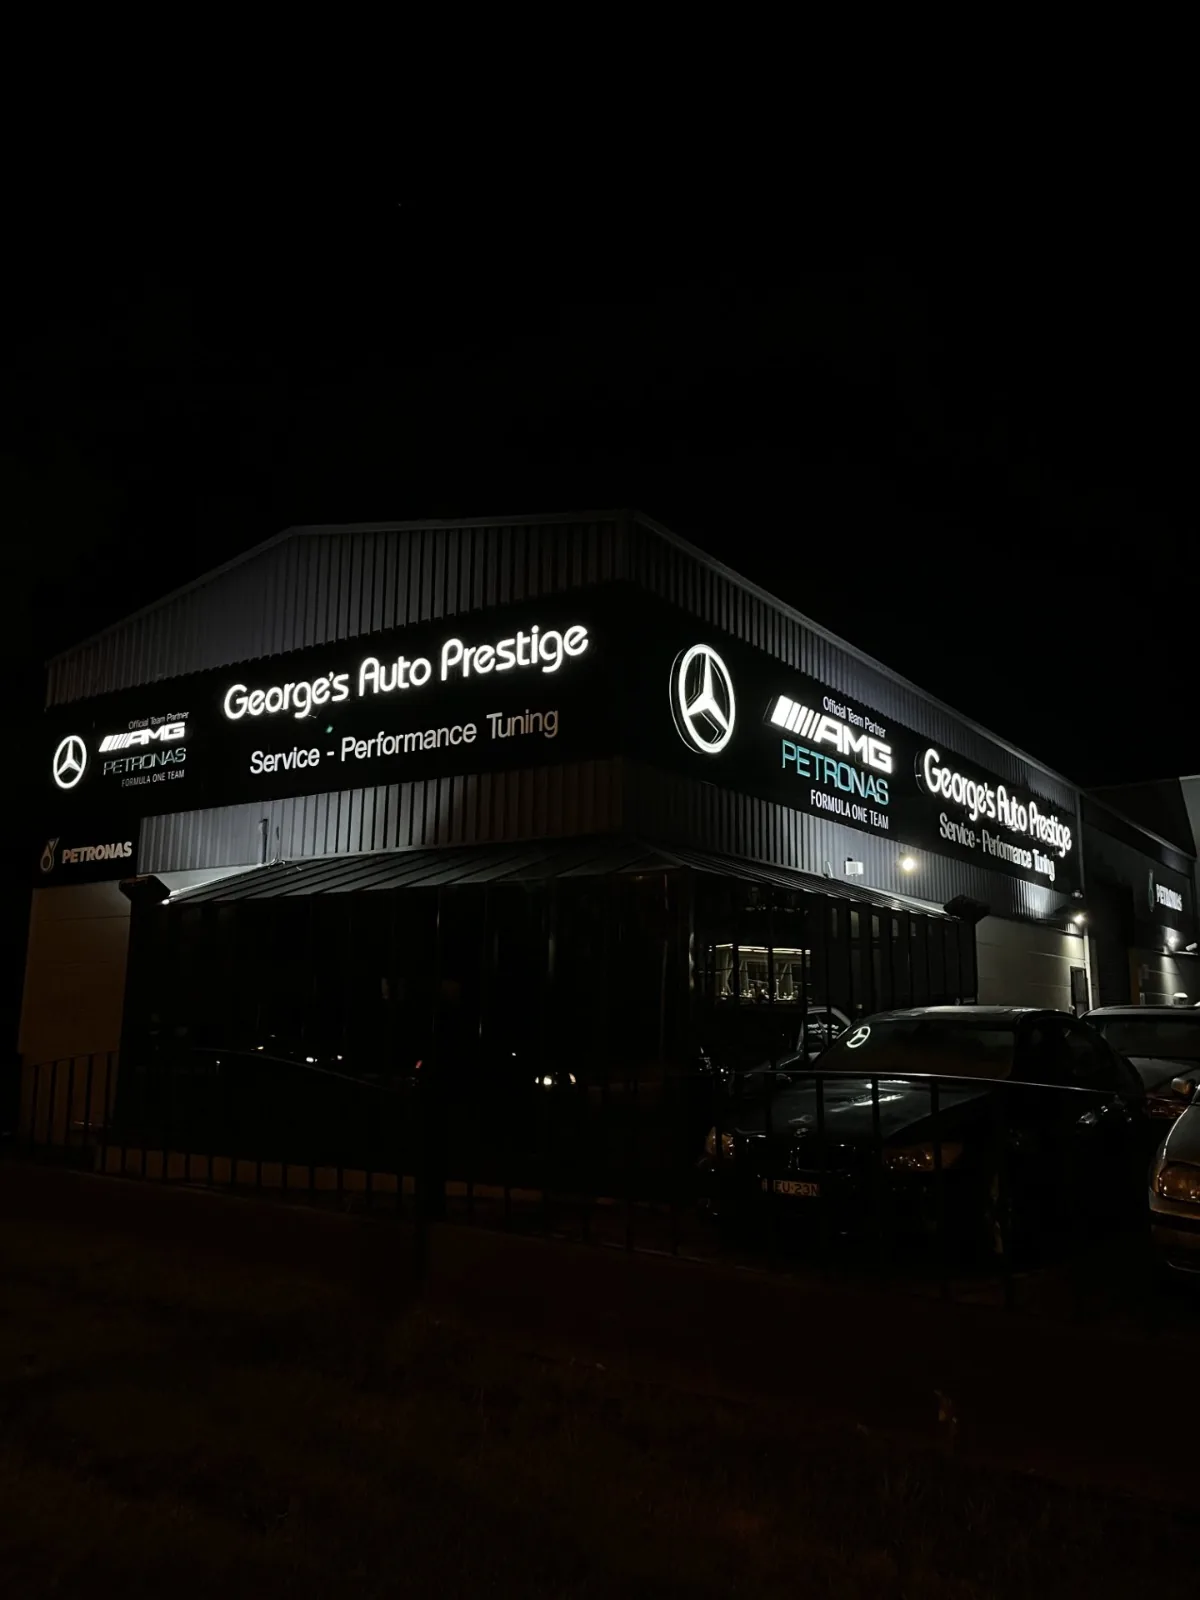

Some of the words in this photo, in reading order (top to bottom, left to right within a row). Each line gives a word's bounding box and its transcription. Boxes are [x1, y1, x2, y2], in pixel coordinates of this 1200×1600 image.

[223, 671, 349, 720] George's
[358, 655, 432, 697] Auto
[440, 624, 589, 681] Prestige
[128, 719, 149, 730] Official
[150, 715, 166, 725] Team
[166, 711, 189, 723] Partner
[822, 696, 847, 719] Official
[846, 707, 864, 728] Team
[864, 716, 887, 738] Partner
[103, 748, 187, 775] PETRONAS
[250, 747, 320, 775] Service
[341, 721, 477, 762] Performance
[486, 708, 560, 740] Tuning
[121, 775, 151, 788] FORMULA
[152, 773, 166, 783] ONE
[168, 769, 185, 780] TEAM
[782, 739, 889, 806] PETRONAS
[810, 789, 851, 818] FORMULA
[851, 804, 868, 824] ONE
[869, 811, 889, 830] TEAM
[923, 748, 996, 822] George's
[996, 785, 1028, 832] Auto
[1028, 800, 1072, 858] Prestige
[61, 841, 133, 864] PETRONAS
[939, 812, 976, 848] Service
[982, 829, 1032, 869] Performance
[1032, 848, 1056, 882] Tuning
